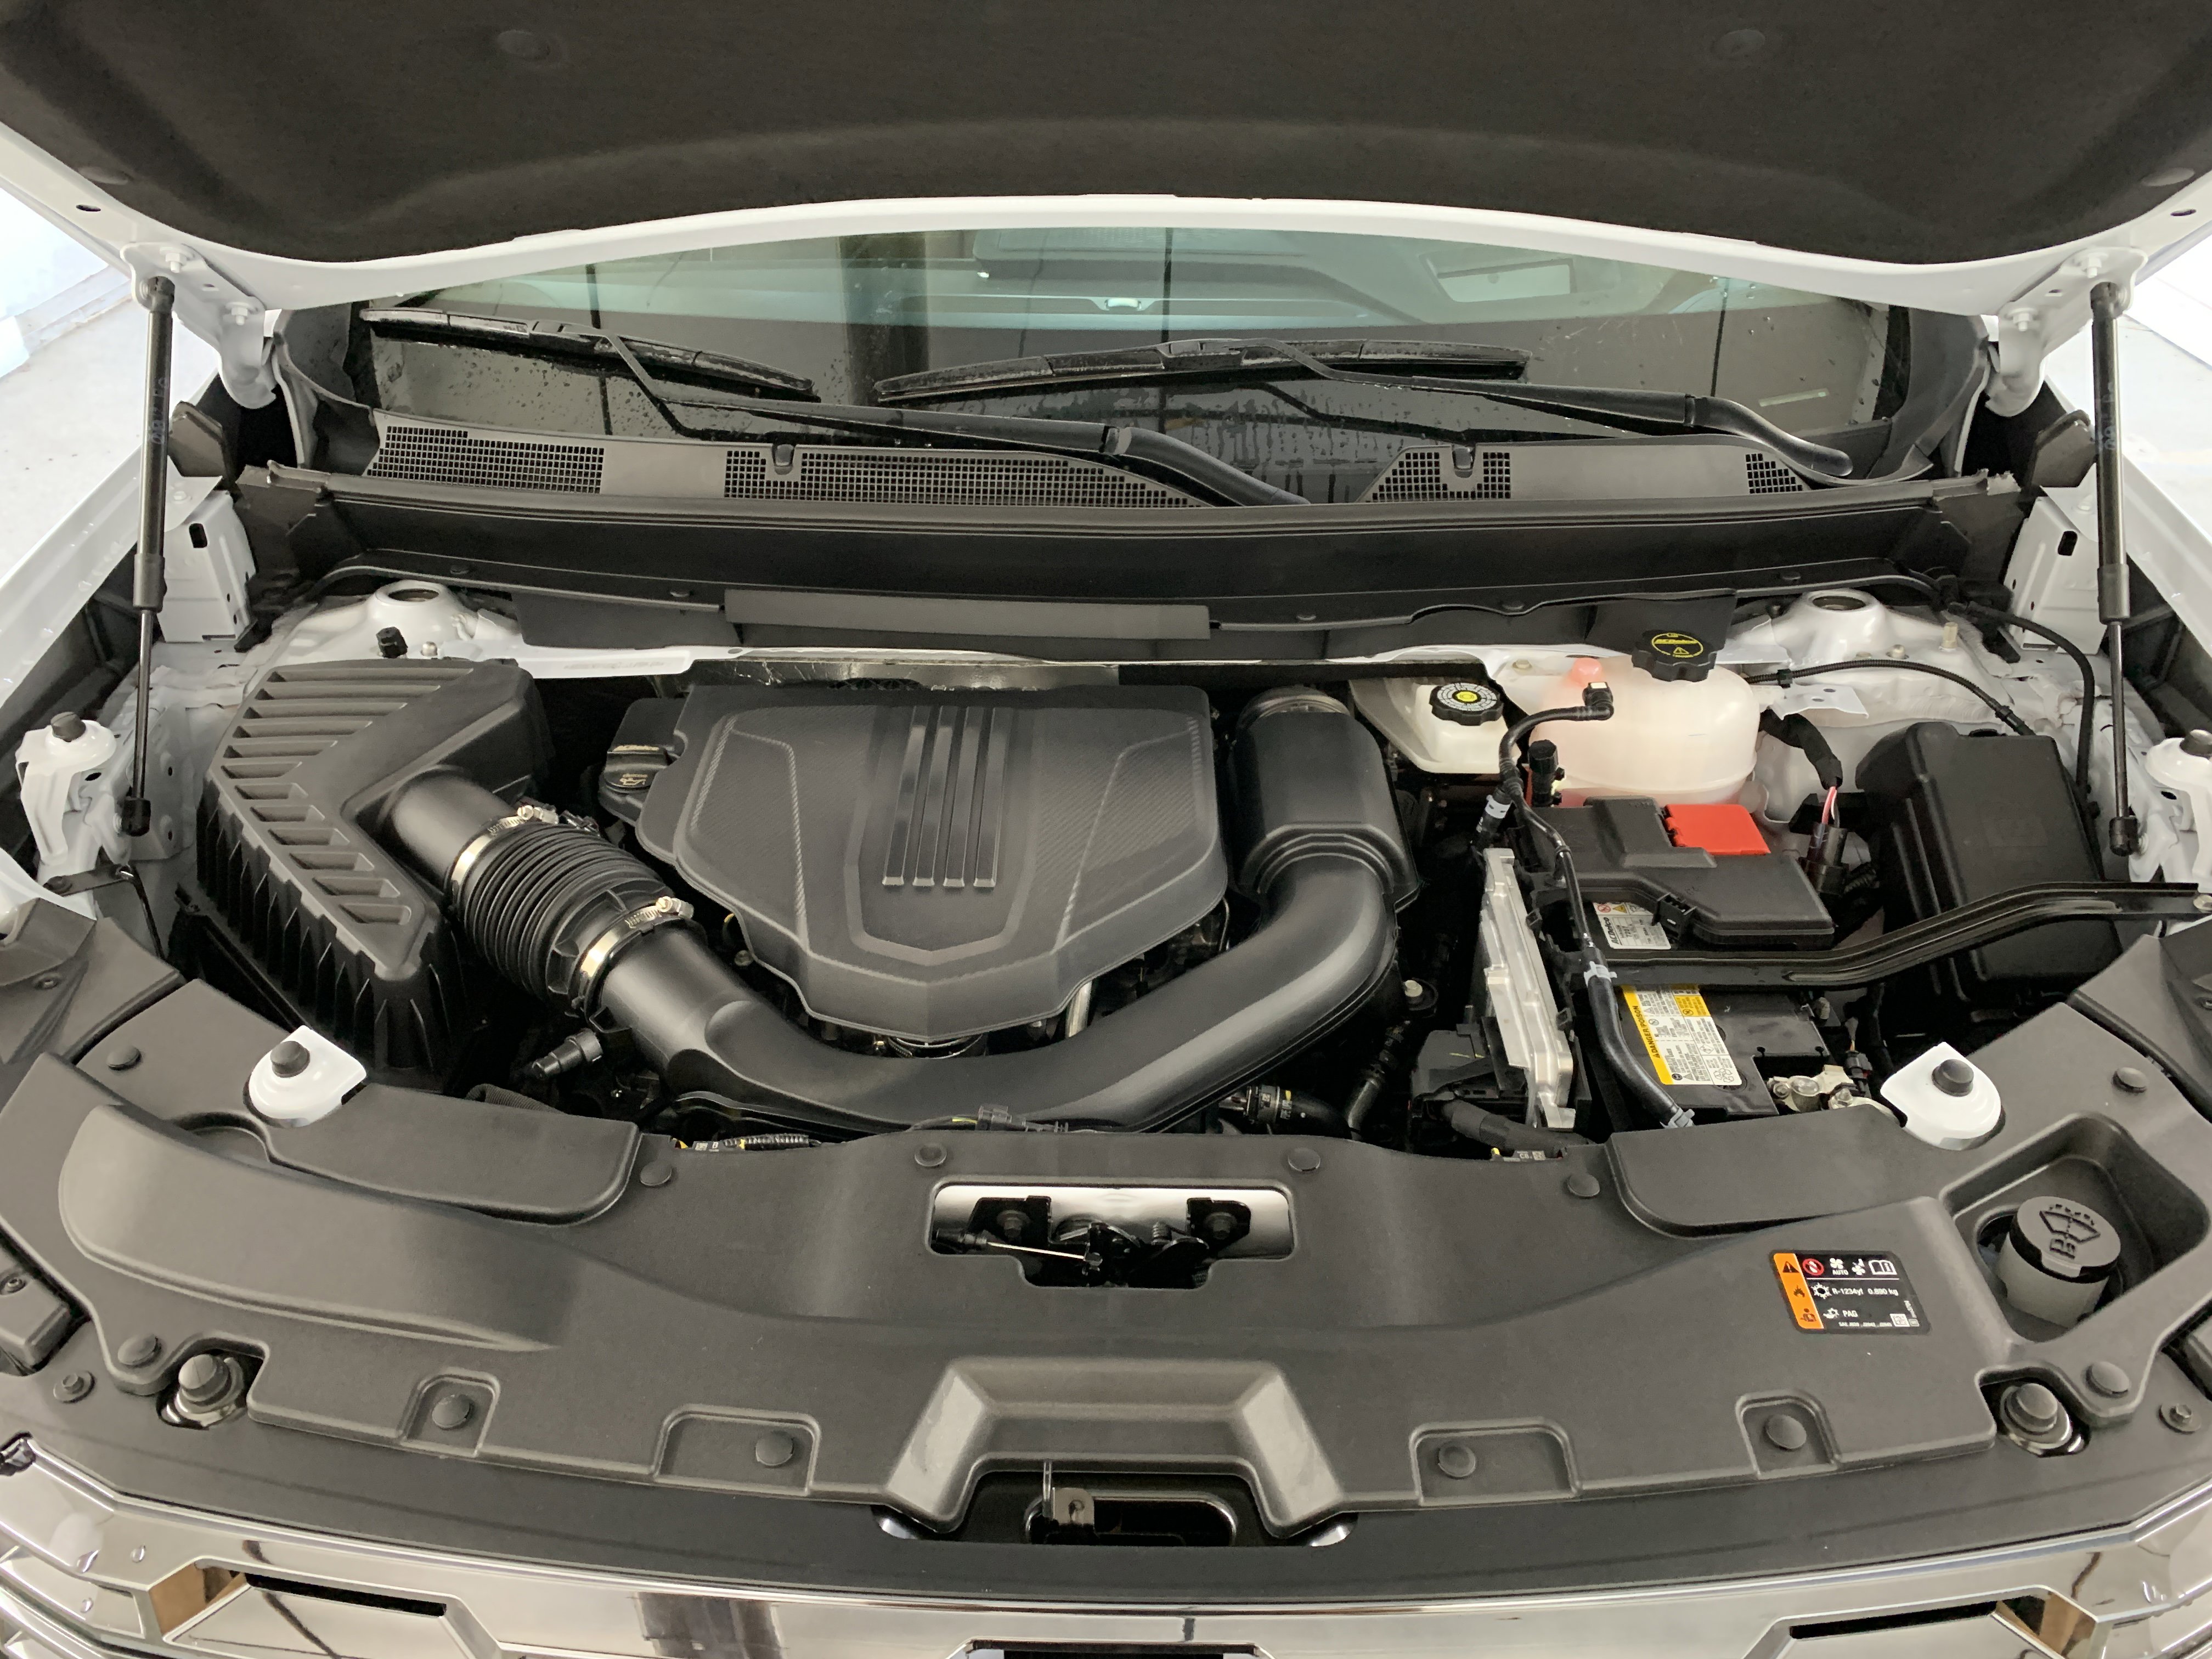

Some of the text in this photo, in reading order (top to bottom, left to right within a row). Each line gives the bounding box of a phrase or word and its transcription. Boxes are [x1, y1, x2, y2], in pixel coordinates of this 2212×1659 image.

[1603, 917, 1620, 944] ACDelco
[1632, 1005, 1659, 1053] DANGER/POISON
[1888, 1288, 1899, 1296] kg
